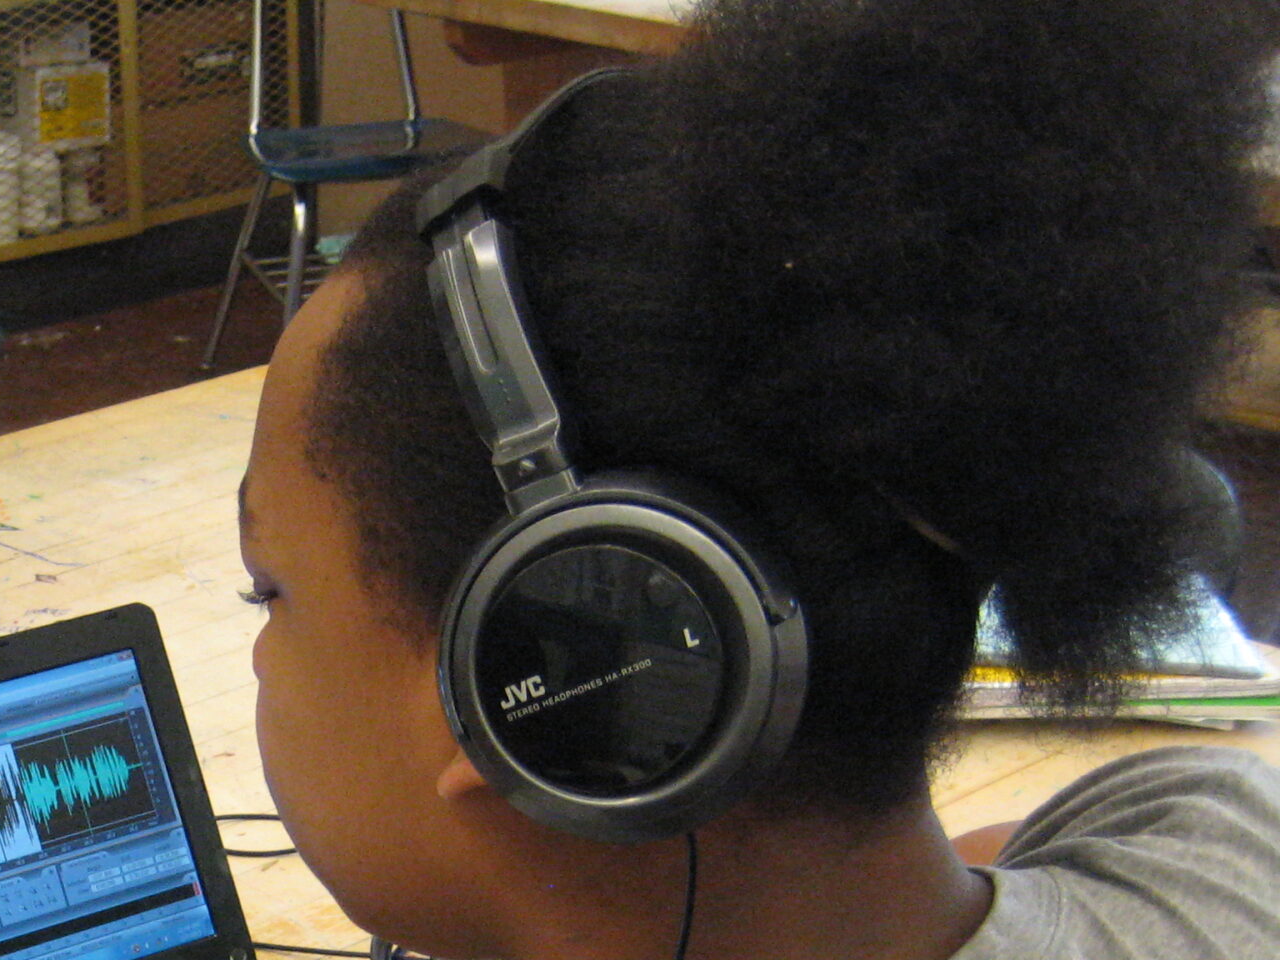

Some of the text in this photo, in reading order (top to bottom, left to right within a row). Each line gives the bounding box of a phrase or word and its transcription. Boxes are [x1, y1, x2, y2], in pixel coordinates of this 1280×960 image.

[683, 627, 700, 648] L
[500, 674, 546, 710] JVC
[506, 704, 540, 722] STEREO
[542, 678, 603, 709] HEADPHONES
